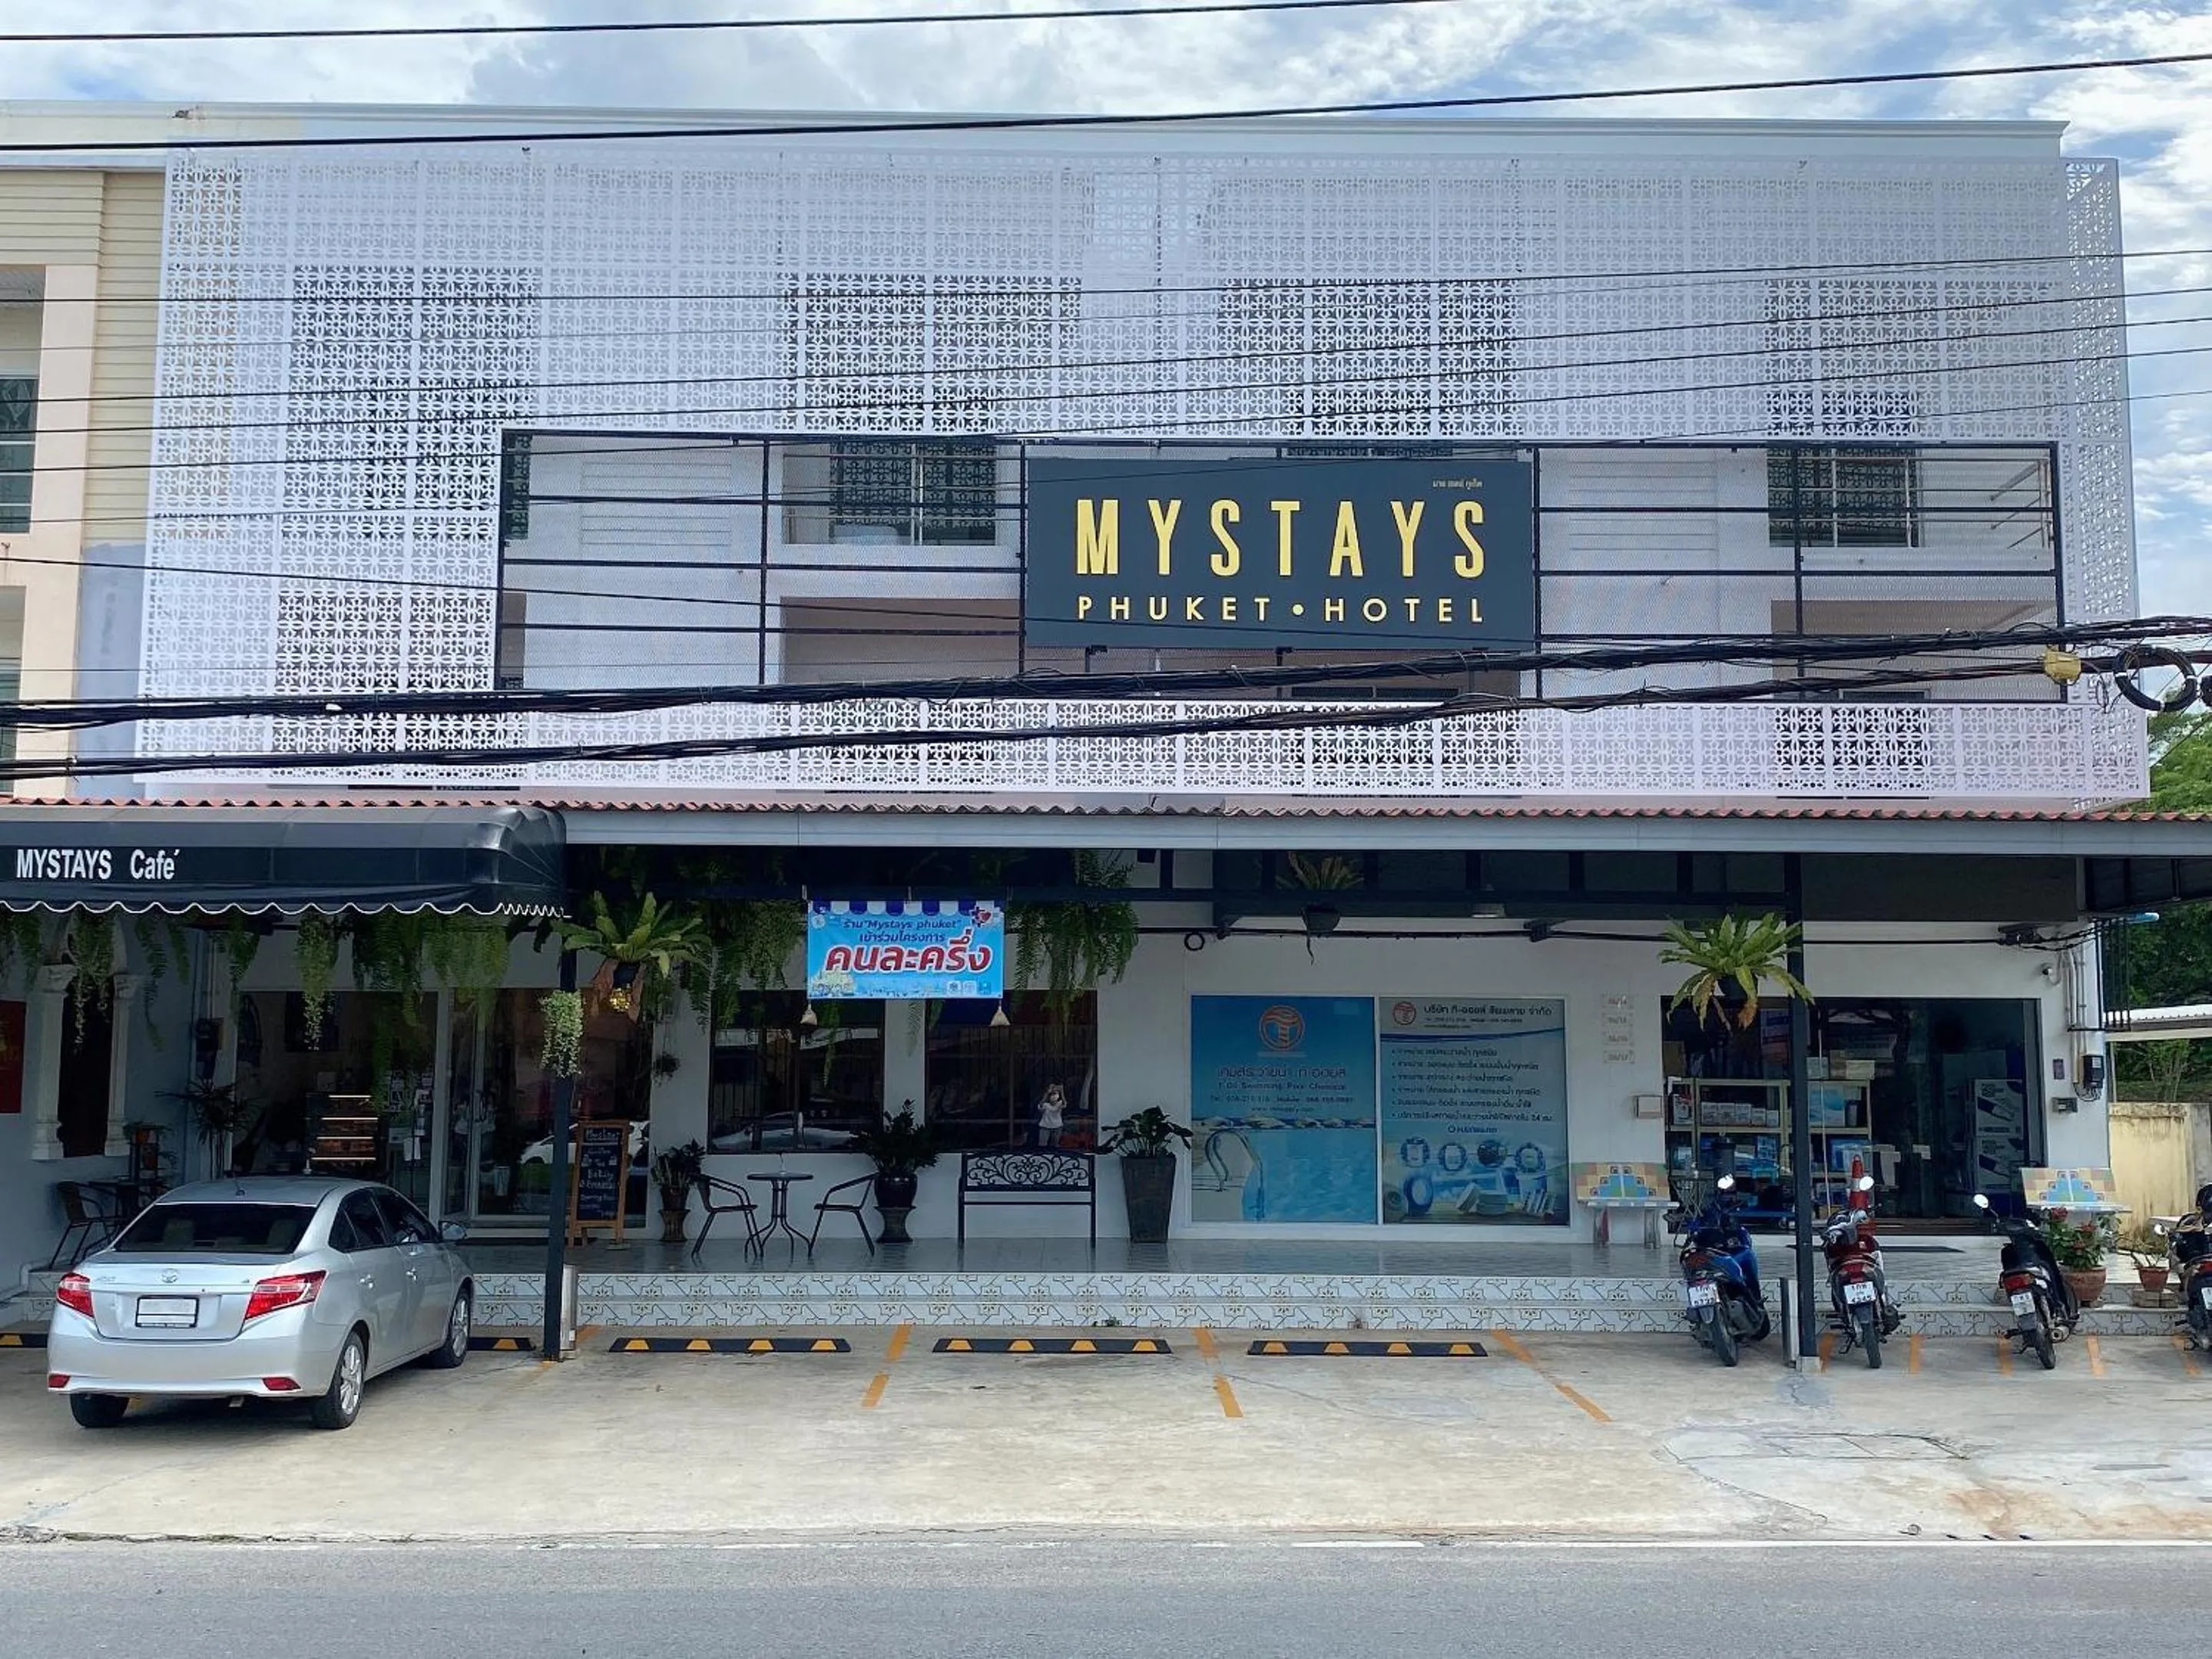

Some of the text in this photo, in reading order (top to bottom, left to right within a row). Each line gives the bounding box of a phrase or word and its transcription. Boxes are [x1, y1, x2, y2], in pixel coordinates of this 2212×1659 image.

[1076, 498, 1485, 578] MYSTAYS
[1078, 596, 1483, 622] PHUKET HOTEL
[16, 849, 113, 879] MYSTAYS
[826, 929, 992, 972] คนละครึ่ง
[859, 931, 945, 943] เข้าร่วมโครงการ
